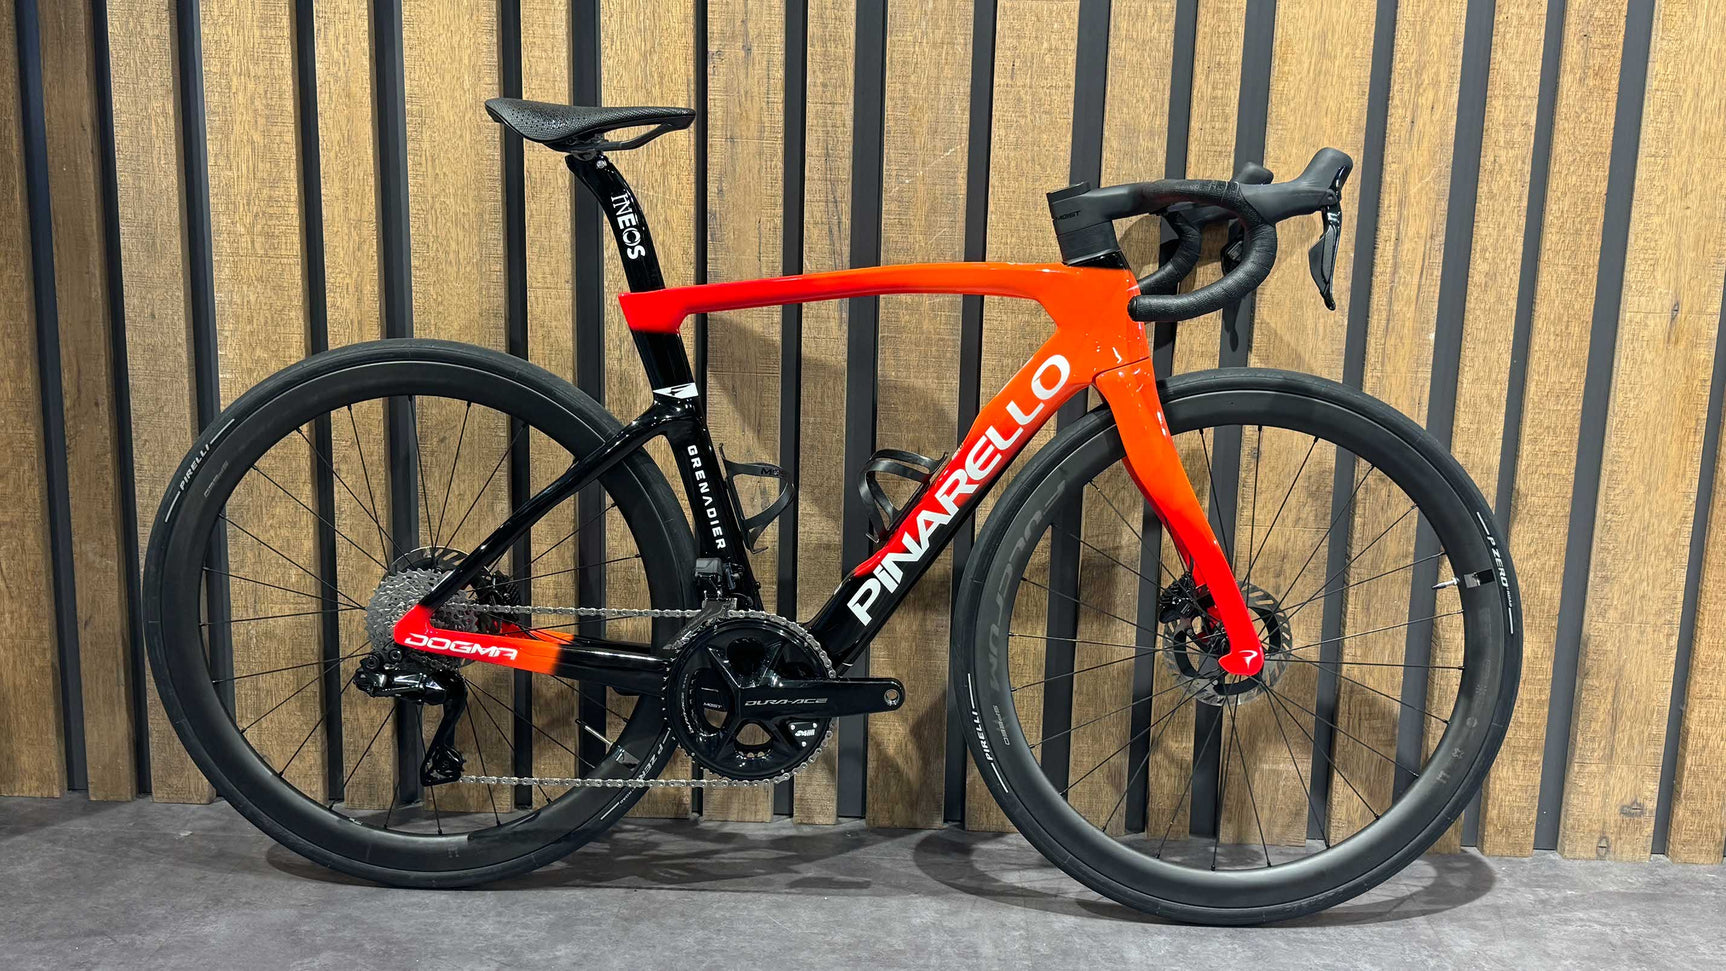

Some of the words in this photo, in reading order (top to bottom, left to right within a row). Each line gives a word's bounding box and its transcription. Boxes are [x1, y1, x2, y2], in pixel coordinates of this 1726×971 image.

[611, 192, 645, 260] INEOS
[179, 443, 210, 491] PIRELLI
[687, 445, 726, 549] GRENADIER
[1487, 536, 1496, 546] P
[1492, 548, 1509, 588] ZERO
[405, 633, 518, 660] DOGMA
[744, 698, 828, 706] DURA-ACE
[971, 711, 994, 761] PIRELLI
